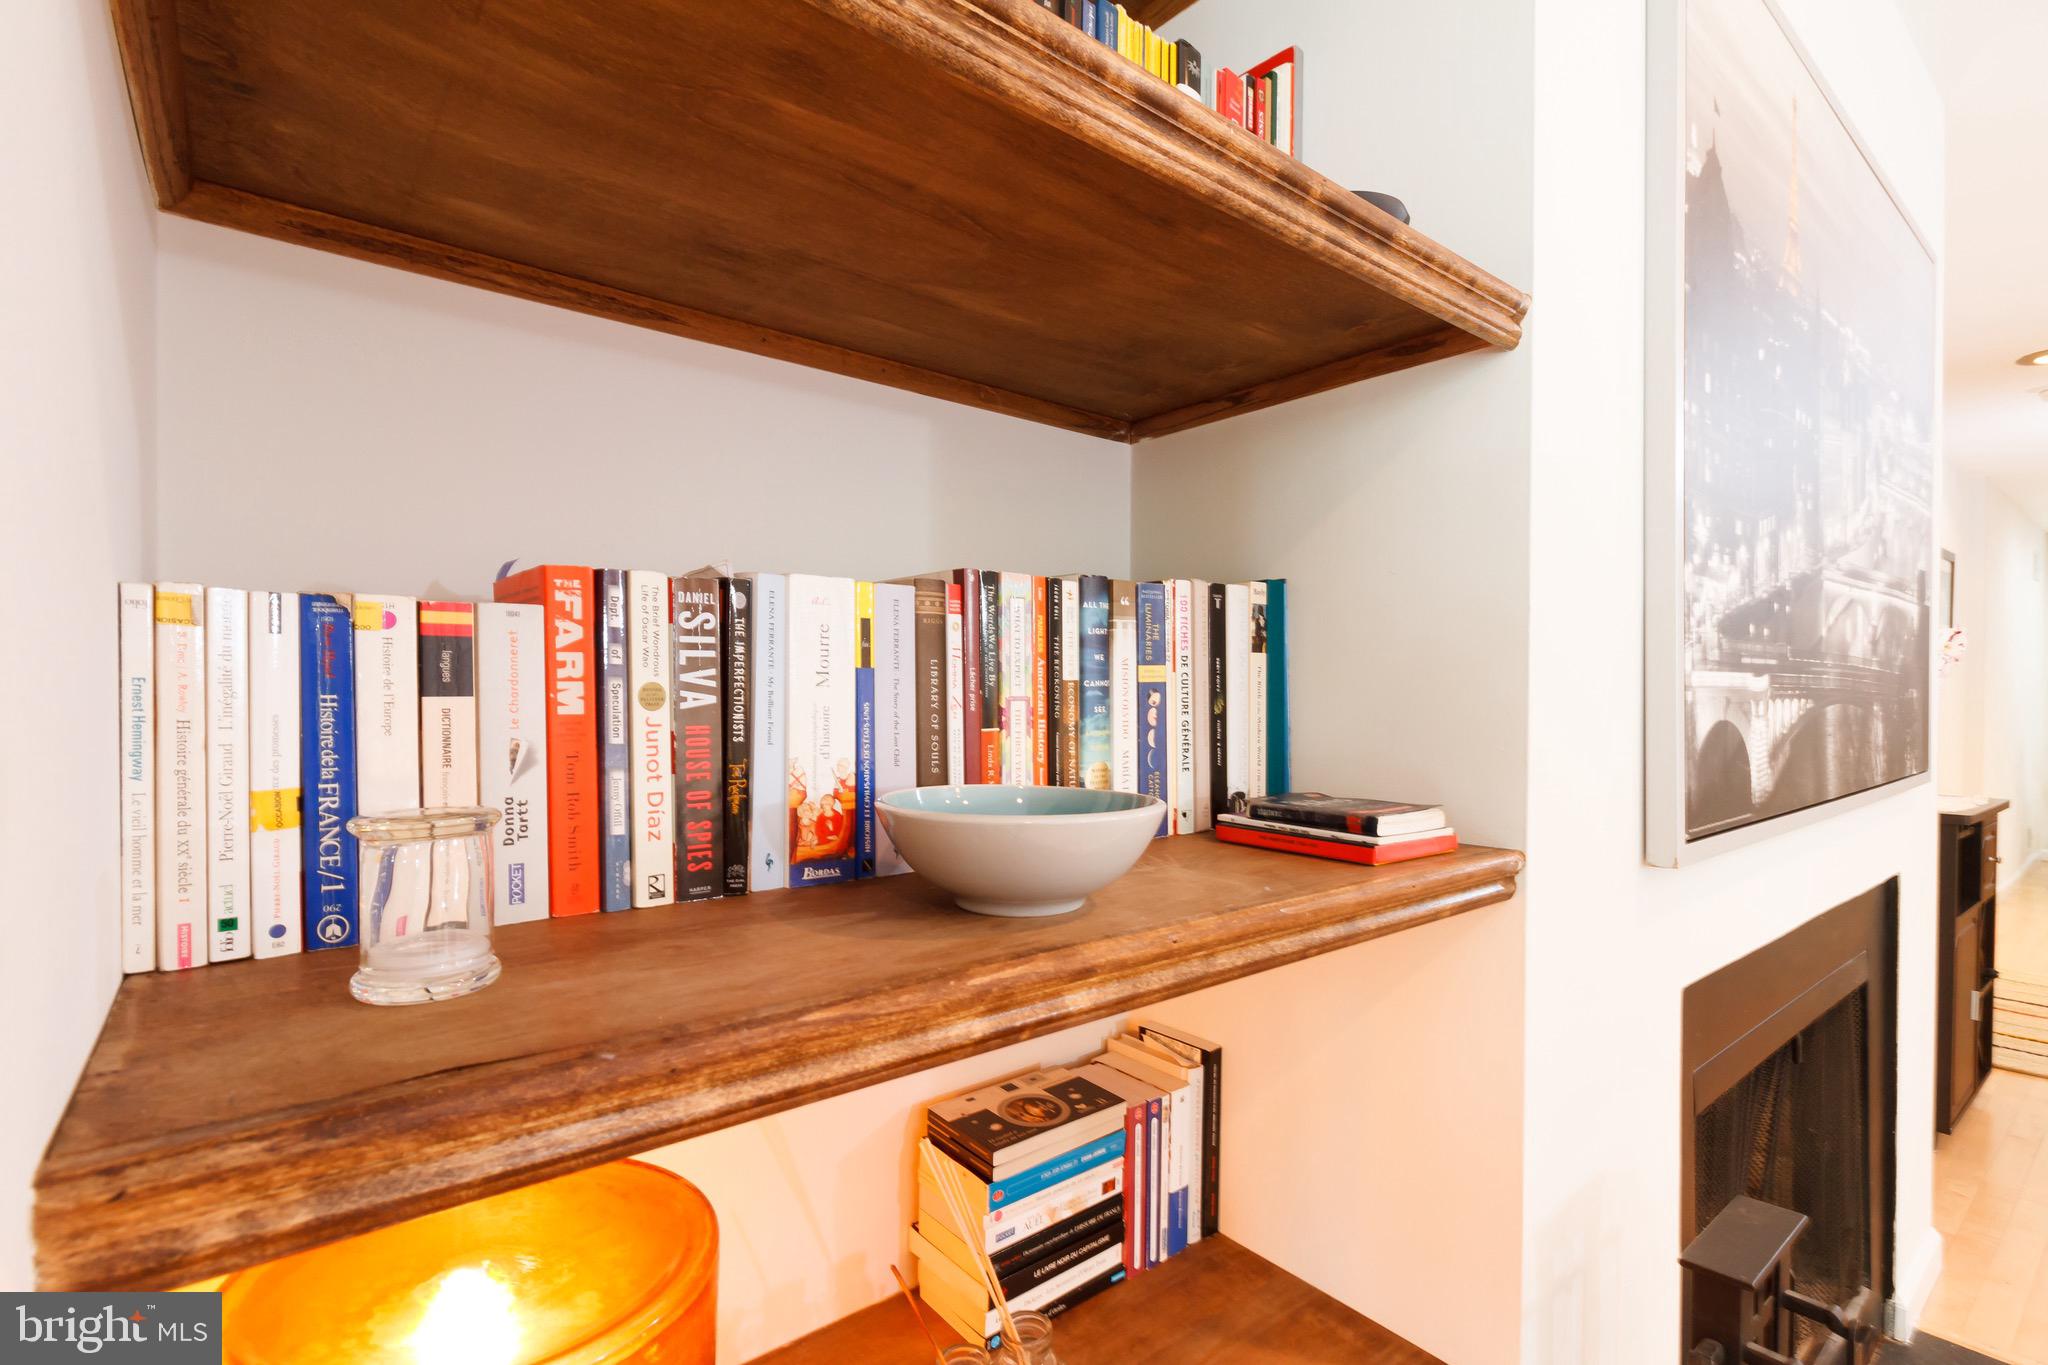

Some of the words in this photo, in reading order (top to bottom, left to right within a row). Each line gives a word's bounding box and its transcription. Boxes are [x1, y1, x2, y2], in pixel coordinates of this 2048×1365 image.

[554, 579, 582, 588] THE
[641, 585, 649, 602] Life
[651, 587, 660, 602] The
[678, 591, 716, 604] DANIEL
[987, 584, 996, 602] The
[609, 595, 620, 620] Dept.
[641, 605, 649, 615] of
[651, 605, 661, 627] Brief
[766, 590, 776, 620] ELENA
[892, 598, 900, 625] ELENA
[987, 605, 996, 633] Words
[1180, 595, 1190, 613] 100
[641, 617, 649, 644] Oscar
[733, 617, 745, 637] THE
[988, 634, 996, 648] We
[1144, 603, 1153, 661] LUMINARIES
[1152, 623, 1160, 641] THE
[1180, 616, 1190, 651] FICHES
[218, 645, 233, 662] du
[382, 637, 395, 677] Histoire
[554, 589, 585, 716] FARM
[611, 649, 621, 659] of
[641, 647, 650, 668] Wao
[652, 631, 662, 677] Wondrous
[677, 611, 717, 710] SILVA
[766, 622, 776, 671] FERRANTE
[815, 623, 831, 689] Mourre
[892, 628, 900, 672] FERRANTE
[988, 651, 996, 672] Live
[1093, 653, 1105, 661] WE
[1180, 655, 1190, 668] DE
[441, 650, 453, 683] langues
[507, 629, 519, 714] Chardonneret
[986, 674, 996, 687] By
[1013, 651, 1022, 688] EXPECT
[131, 677, 147, 714] Ernest
[217, 665, 238, 731] L'inégalité
[383, 679, 395, 692] de
[732, 641, 746, 743] IMPERFECTIONISTS
[930, 659, 939, 709] LIBRARY
[1036, 657, 1046, 715] American
[1180, 672, 1191, 716] CULTURE
[320, 694, 340, 748] Histoire
[382, 694, 396, 737] l'Europe
[507, 716, 520, 730] Le
[611, 683, 622, 739] Speculation
[930, 714, 939, 730] OF
[1067, 682, 1075, 737] ECONOMY
[176, 719, 191, 766] Histoire
[272, 714, 285, 757] promesses
[441, 707, 453, 768] DICTIONNAIRE
[818, 704, 831, 760] d'histoire
[1035, 719, 1046, 764] History
[1068, 741, 1075, 754] OF
[1181, 720, 1193, 773] GÉNÉRALE
[130, 715, 147, 782] Hemingway
[320, 749, 340, 765] de
[644, 716, 664, 782] Junot
[684, 725, 713, 781] HOUSE
[930, 735, 939, 774] SOULS
[217, 743, 233, 787] Giraud
[268, 760, 280, 774] des
[320, 766, 340, 780] la
[567, 754, 581, 785] Tom
[729, 759, 747, 778] Tom
[1068, 757, 1076, 787] NATU
[133, 792, 146, 806] Le
[173, 768, 192, 818] générale
[686, 791, 713, 811] OF
[728, 780, 747, 815] Rachman
[1154, 771, 1162, 801] ELEANO
[132, 808, 146, 832] vieil
[274, 791, 284, 829] OCCASION
[502, 796, 515, 847] Donna
[516, 799, 529, 842] Tartt
[567, 792, 582, 820] Rob
[646, 792, 665, 842] Díaz
[176, 821, 191, 836] du
[217, 791, 233, 862] Pierre-Noël
[132, 834, 146, 877] homme
[567, 826, 582, 872] Smith
[686, 820, 713, 873] SPIES
[132, 879, 143, 889] et
[177, 862, 192, 894] siècle
[510, 863, 524, 904] POCKET
[689, 885, 712, 893] HARPER
[802, 866, 842, 881] BORDAS
[132, 891, 146, 904] la
[131, 906, 143, 926] mer
